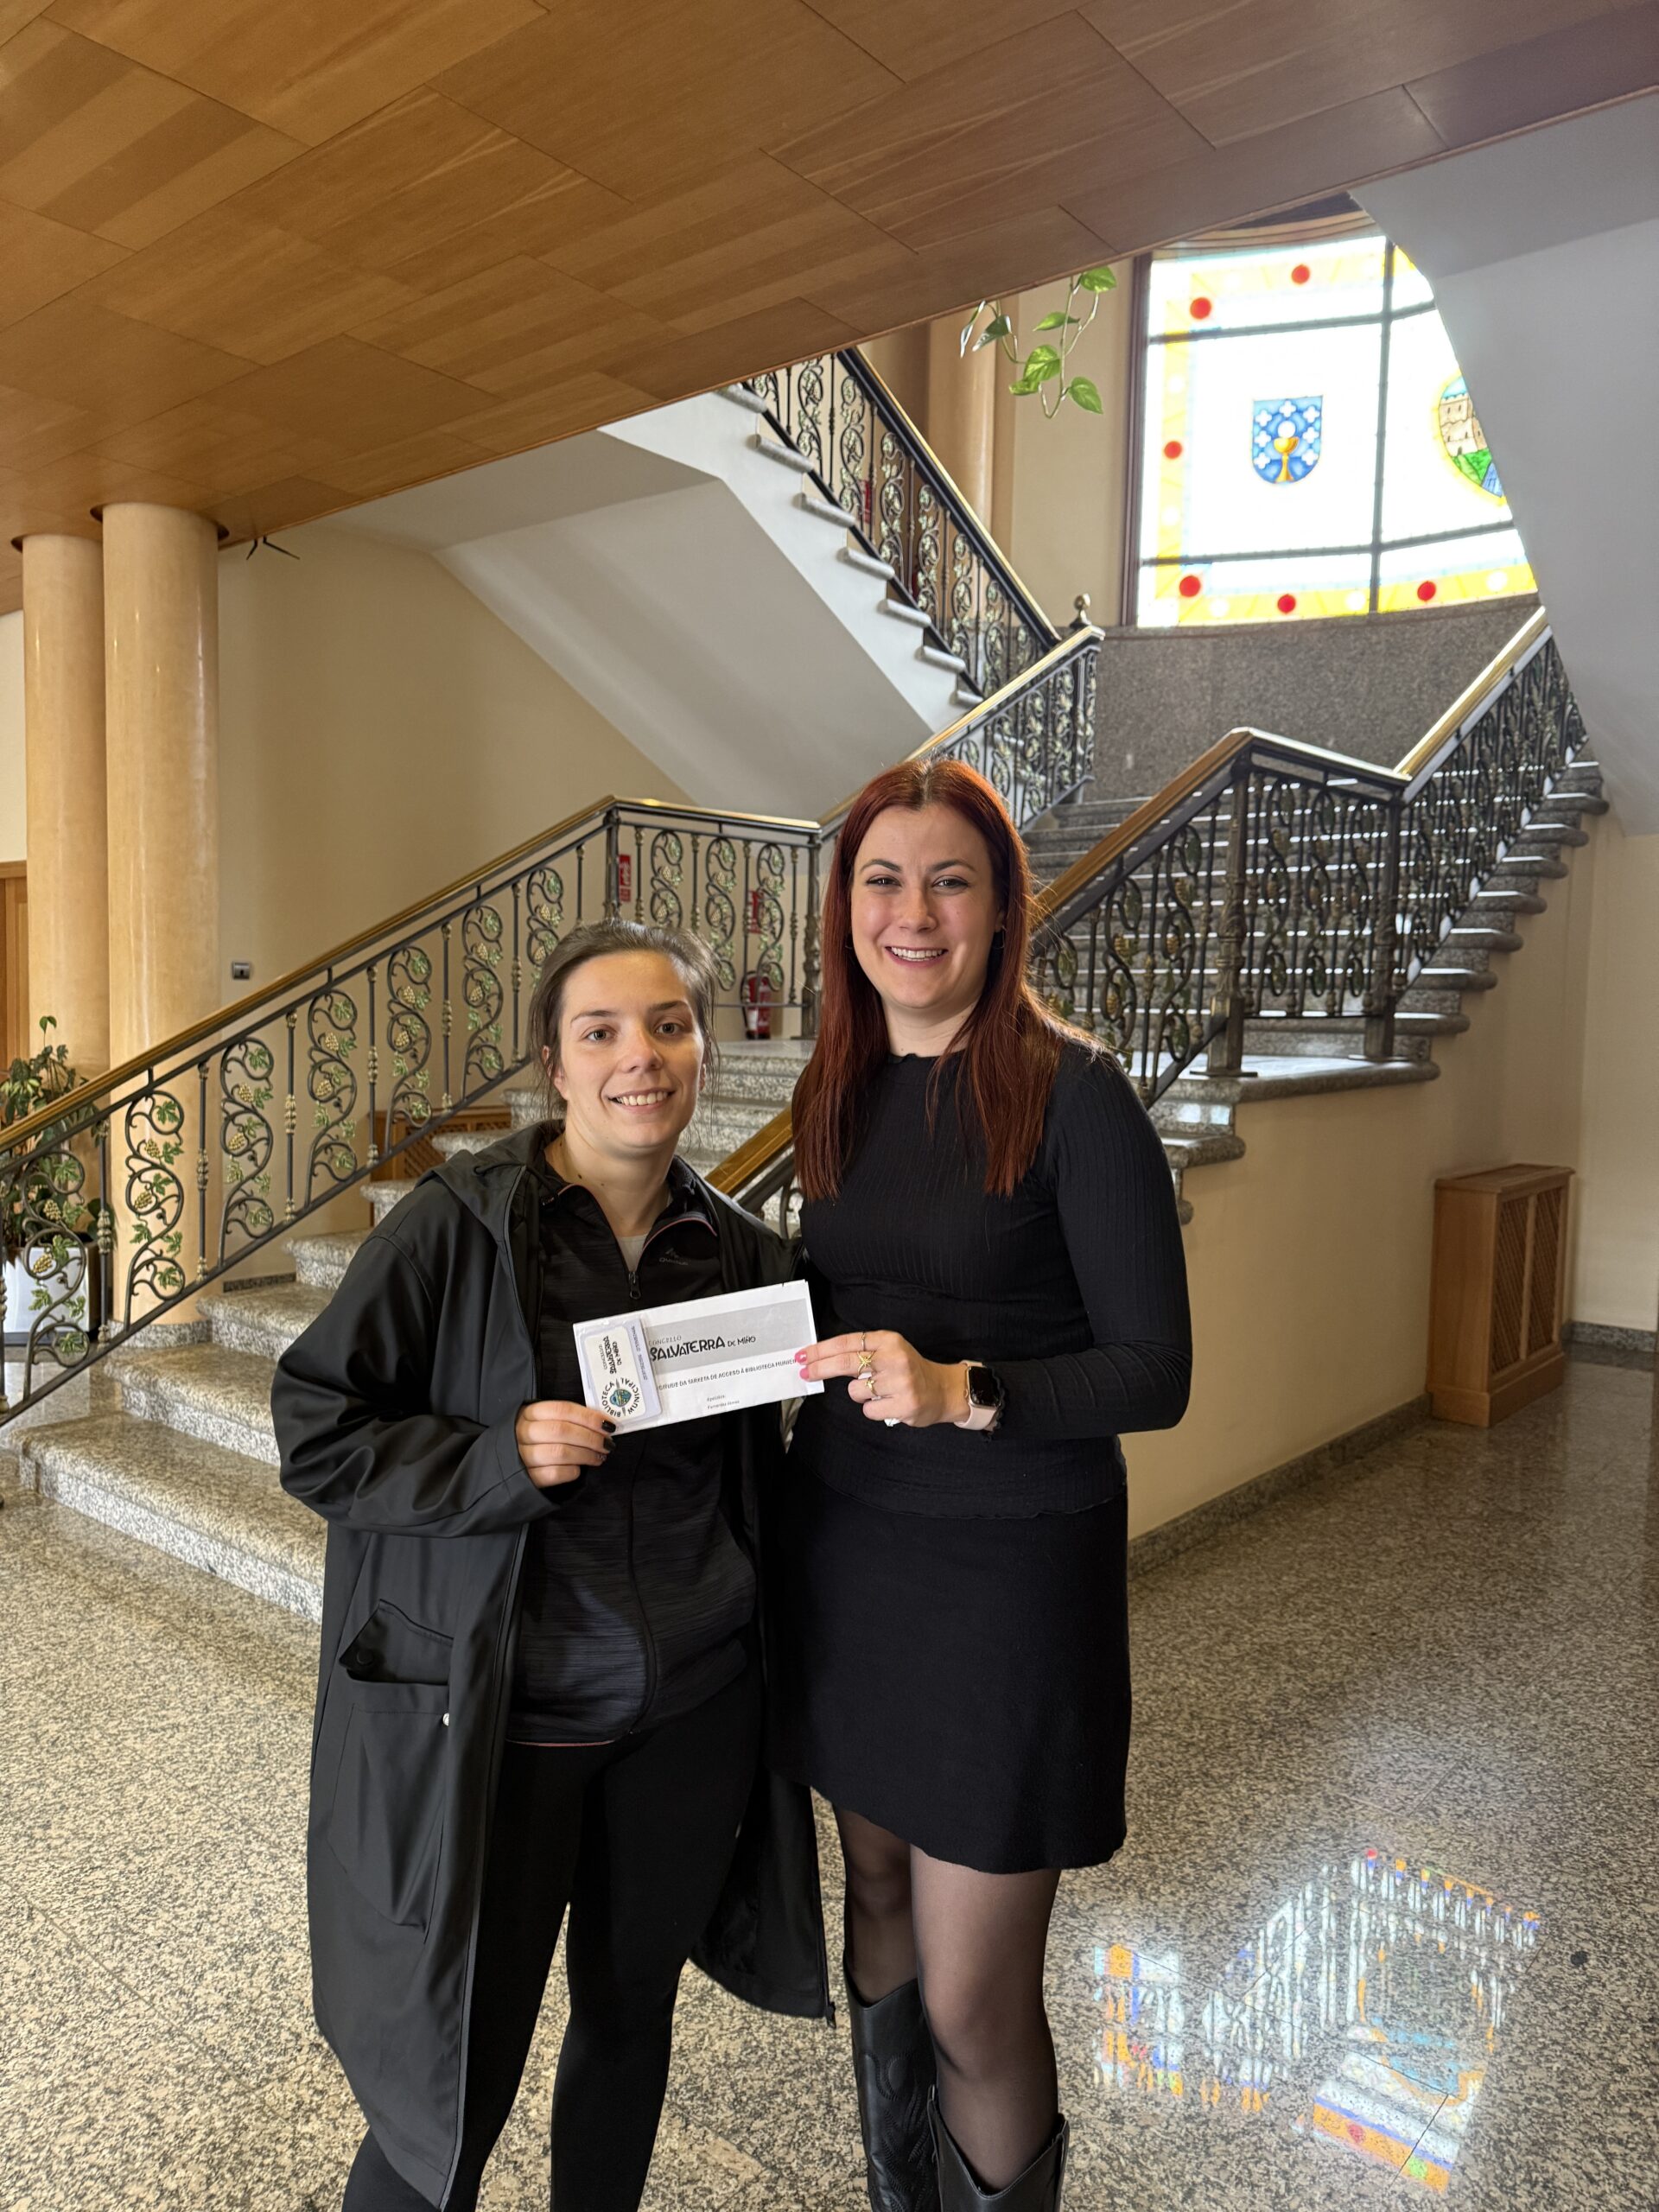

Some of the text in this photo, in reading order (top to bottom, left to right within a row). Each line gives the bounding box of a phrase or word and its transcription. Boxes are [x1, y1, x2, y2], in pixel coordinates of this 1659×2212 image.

[648, 1336, 682, 1347] CONCELLO
[649, 1336, 726, 1362] SALVATERRA
[737, 1335, 757, 1346] MIÑO
[657, 1382, 678, 1390] CITUDE
[718, 1370, 741, 1378] ACCESO
[746, 1363, 775, 1373] BIBLIOTECA
[601, 1377, 640, 1417] BIBLIOTECA MUNICIPAL
